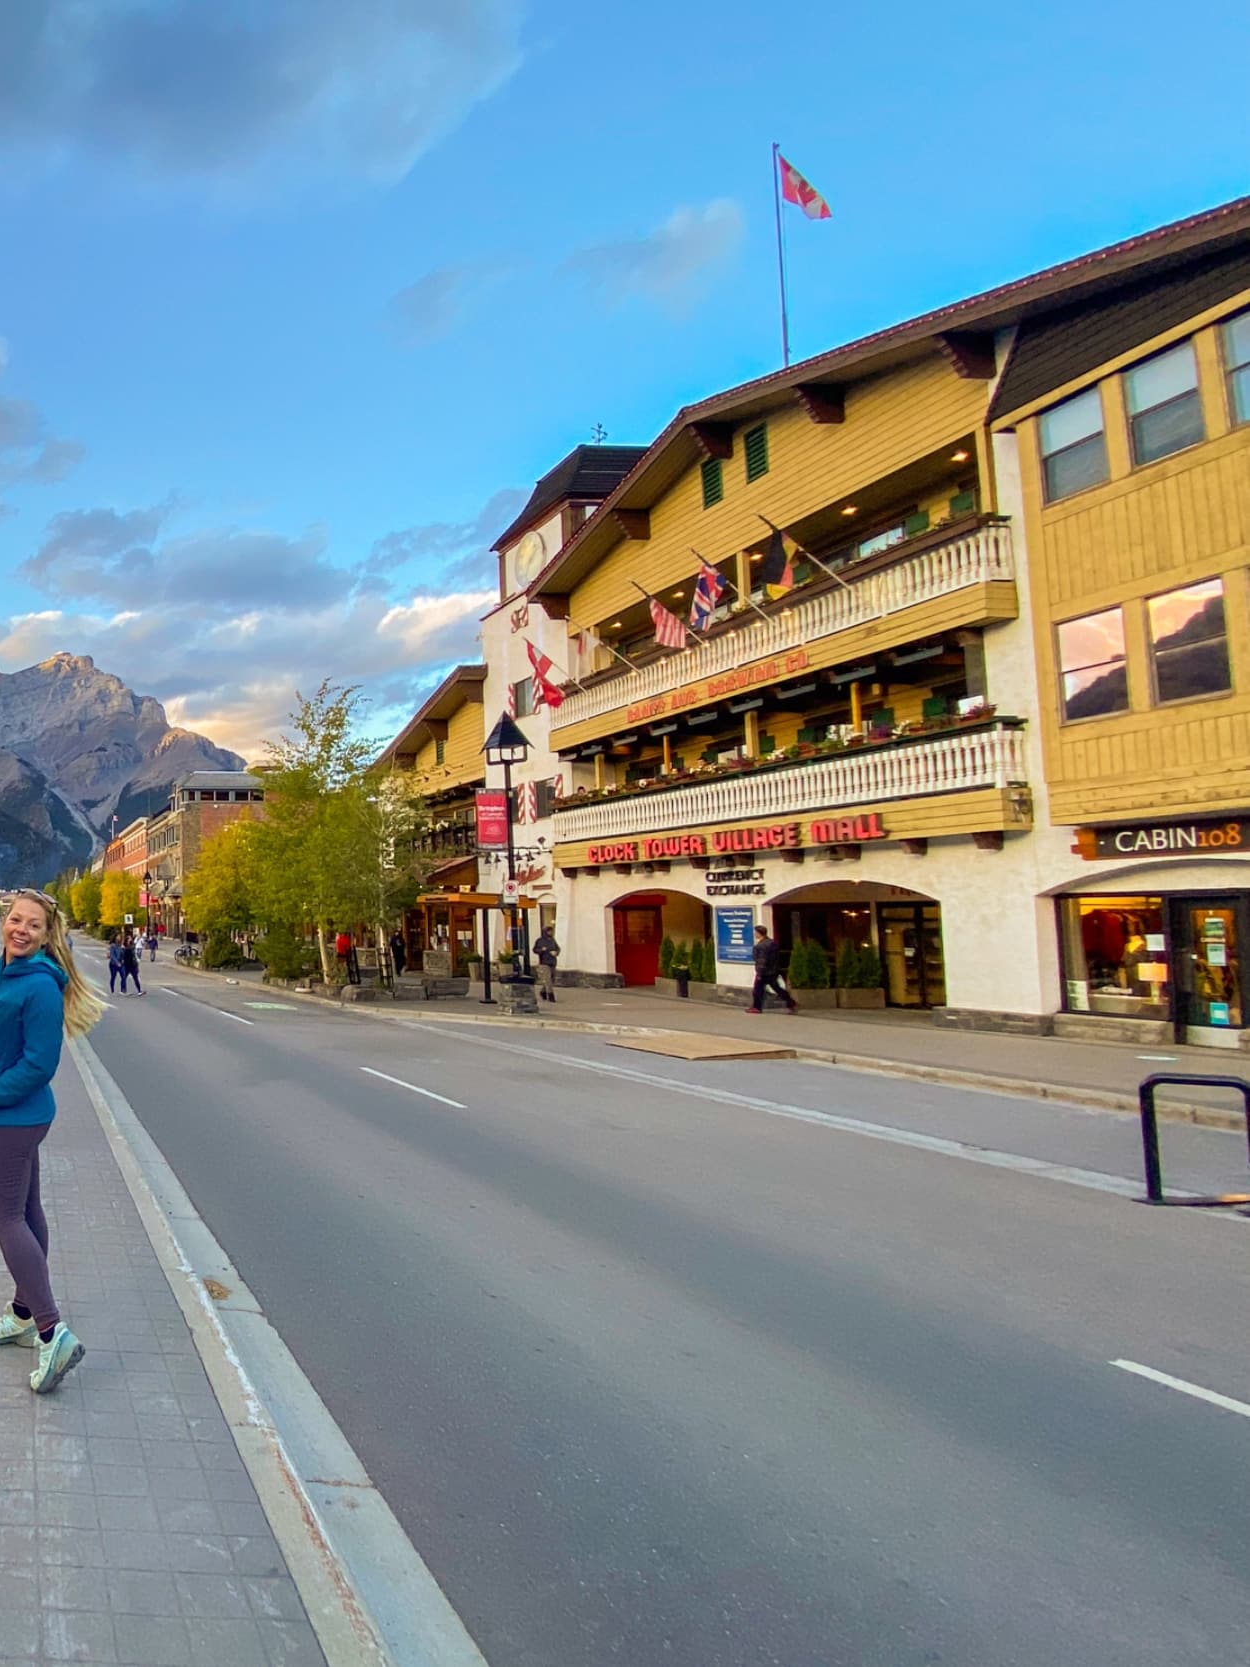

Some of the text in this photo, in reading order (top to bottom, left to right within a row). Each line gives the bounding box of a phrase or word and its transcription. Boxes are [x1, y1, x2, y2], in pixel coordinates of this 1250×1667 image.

[588, 812, 888, 863] CLOCK TOWER VILLAGE MALL
[706, 869, 765, 883] CURRENCY
[706, 884, 767, 896] EXCHANGE
